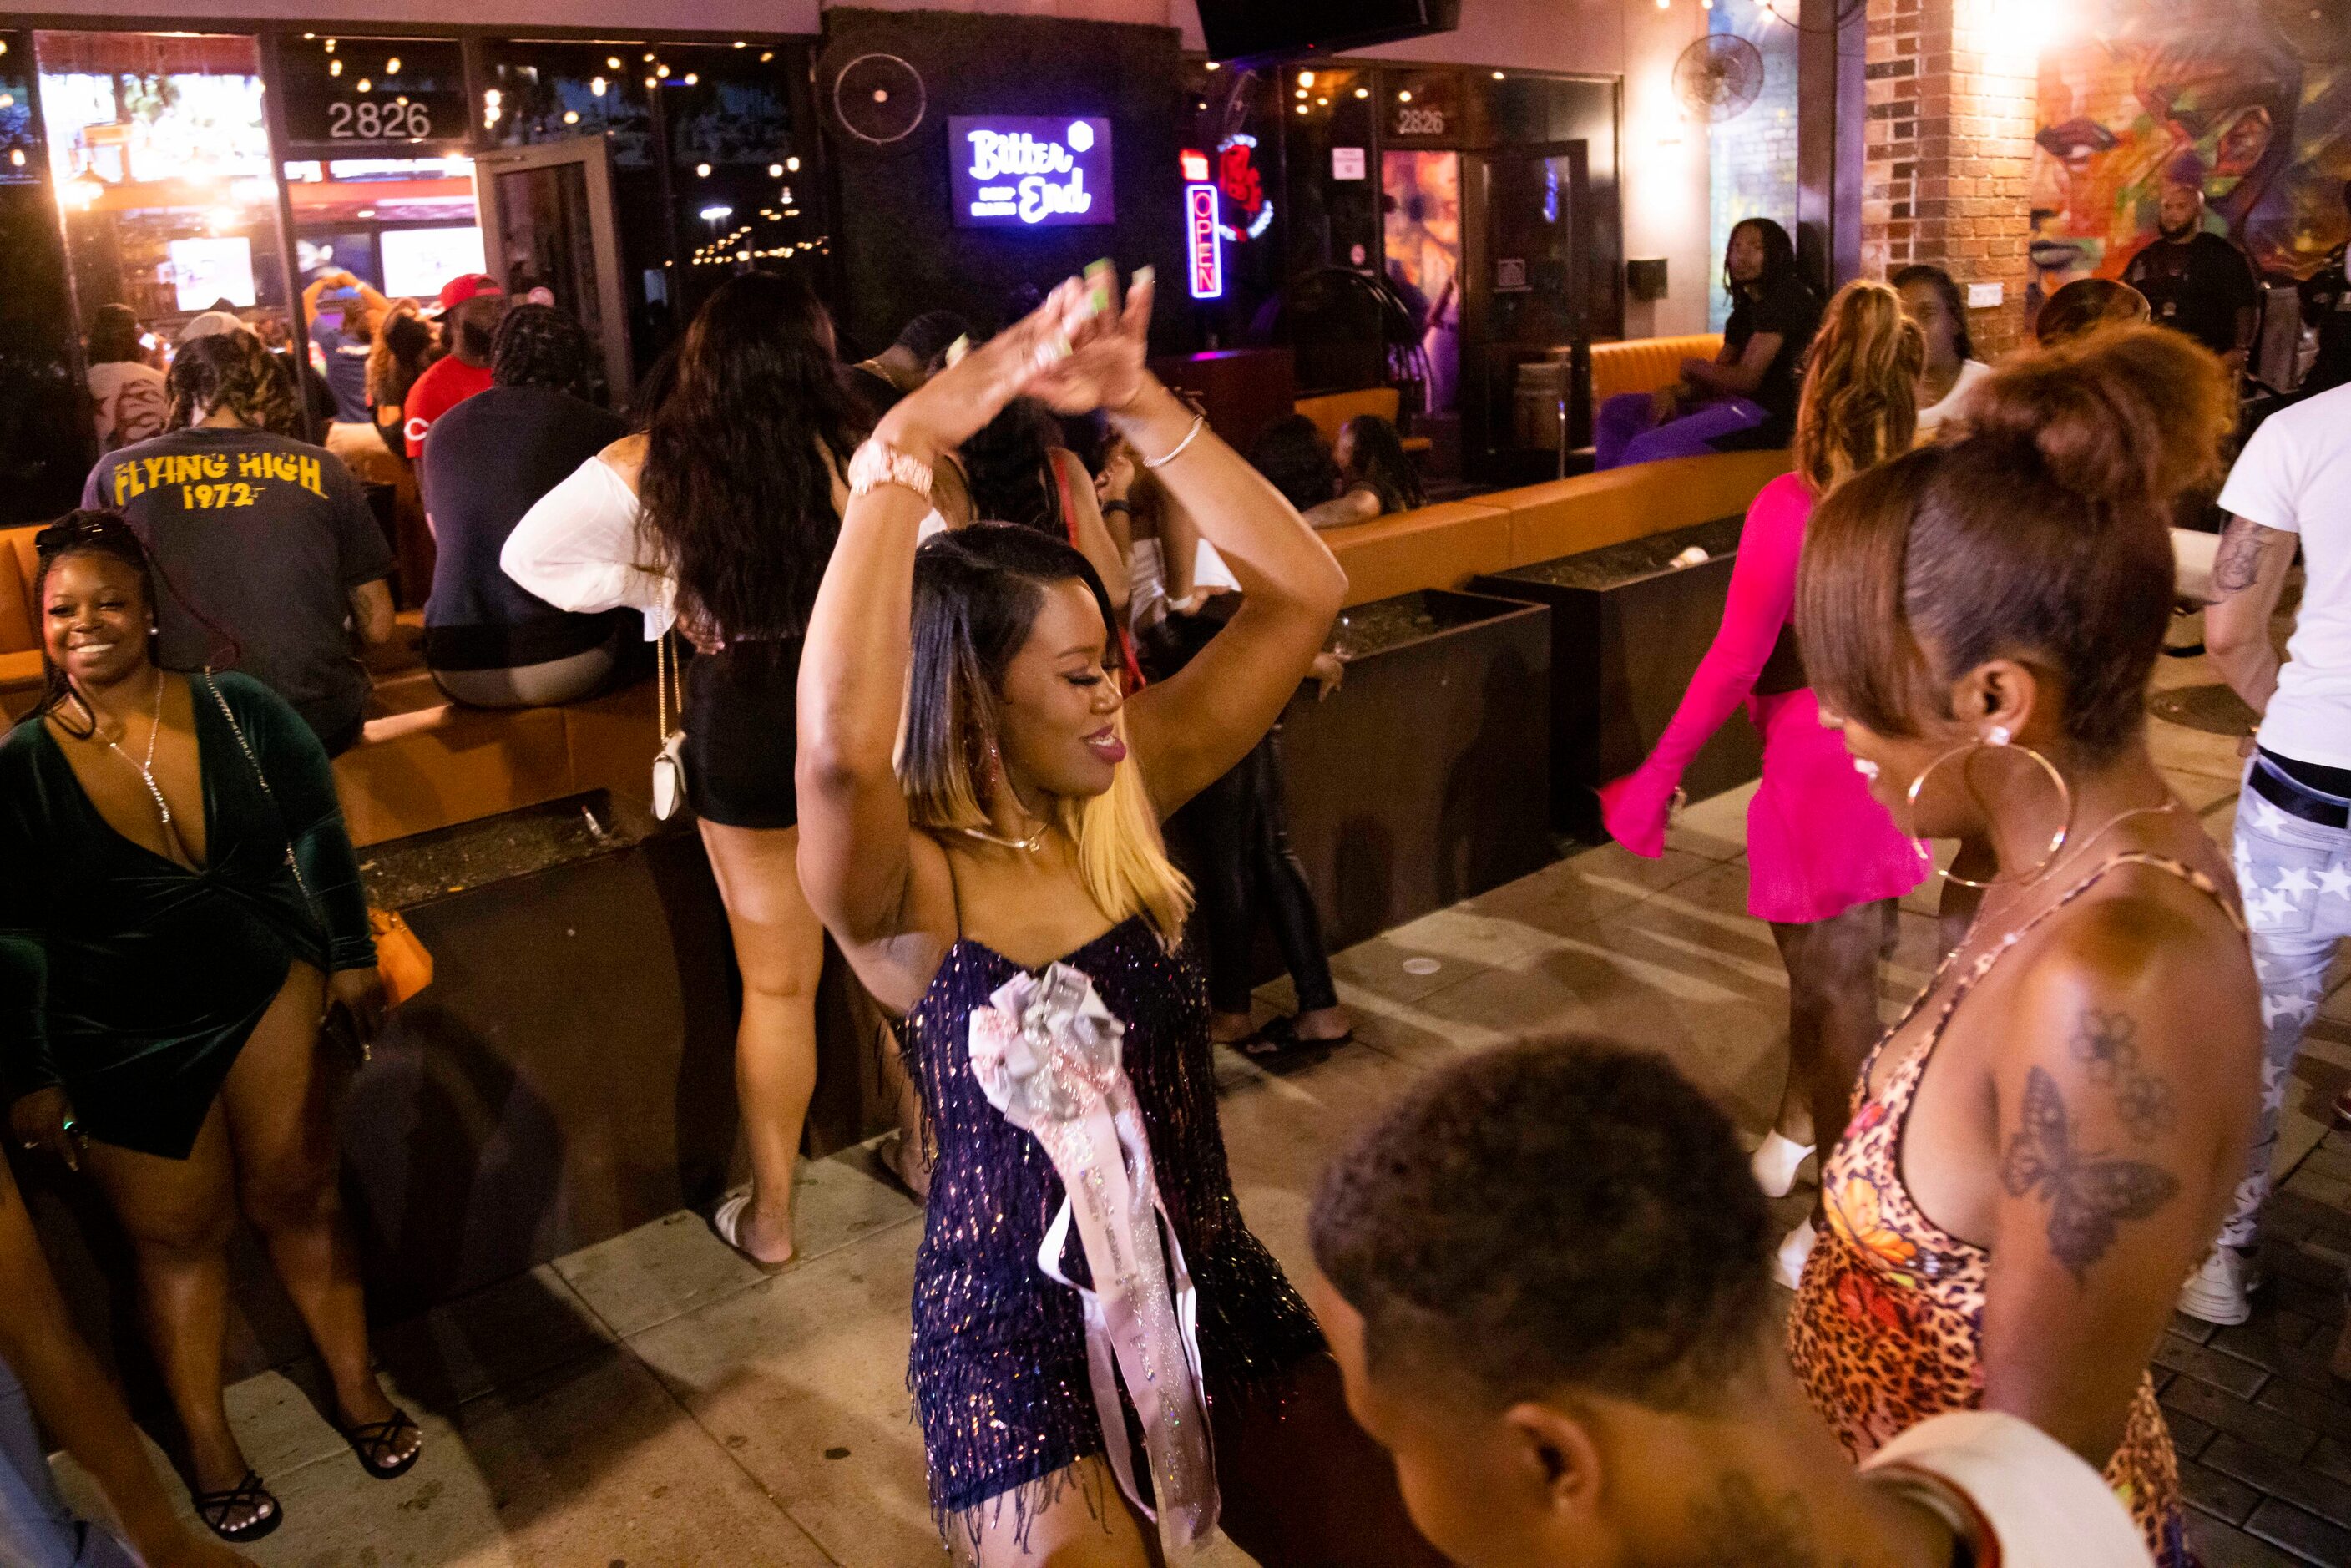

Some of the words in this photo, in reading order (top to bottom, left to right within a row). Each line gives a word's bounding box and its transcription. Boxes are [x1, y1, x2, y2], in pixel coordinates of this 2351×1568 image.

[329, 102, 431, 138] 2826
[1398, 109, 1445, 134] 2826
[968, 129, 1074, 180] Bitter
[1019, 167, 1092, 224] End
[1193, 191, 1216, 292] OPEN
[403, 417, 429, 441] C
[114, 454, 229, 506] FLYING
[238, 453, 322, 496] HIGH
[182, 482, 255, 509] 1972
